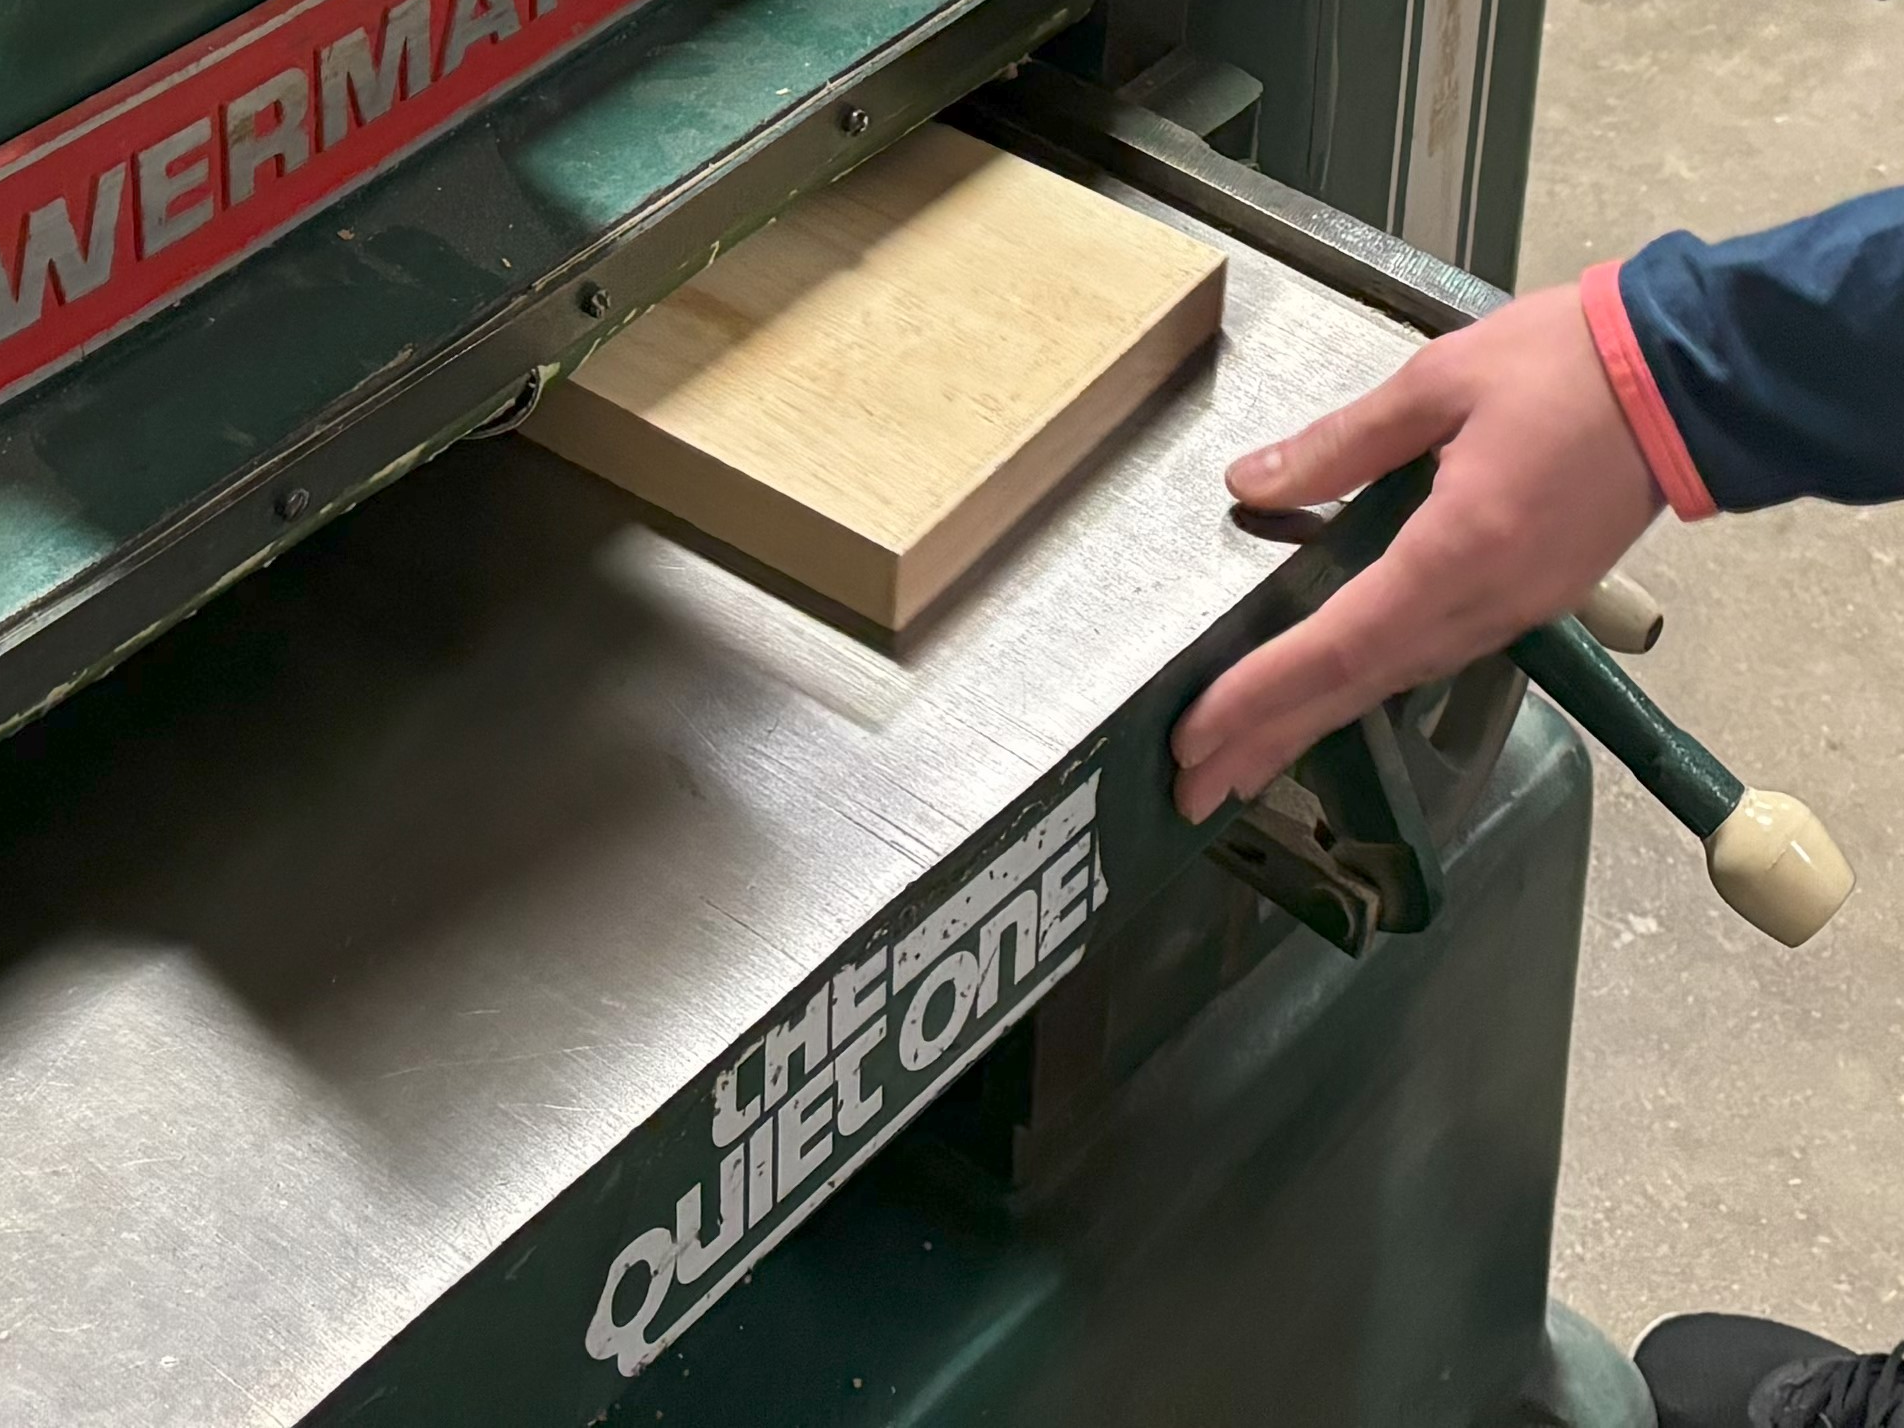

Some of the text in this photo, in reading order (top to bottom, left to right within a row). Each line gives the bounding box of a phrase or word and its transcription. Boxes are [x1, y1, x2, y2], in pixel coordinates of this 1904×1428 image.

[584, 830, 1091, 1378] QUIET ONE
[712, 944, 890, 1149] THE
